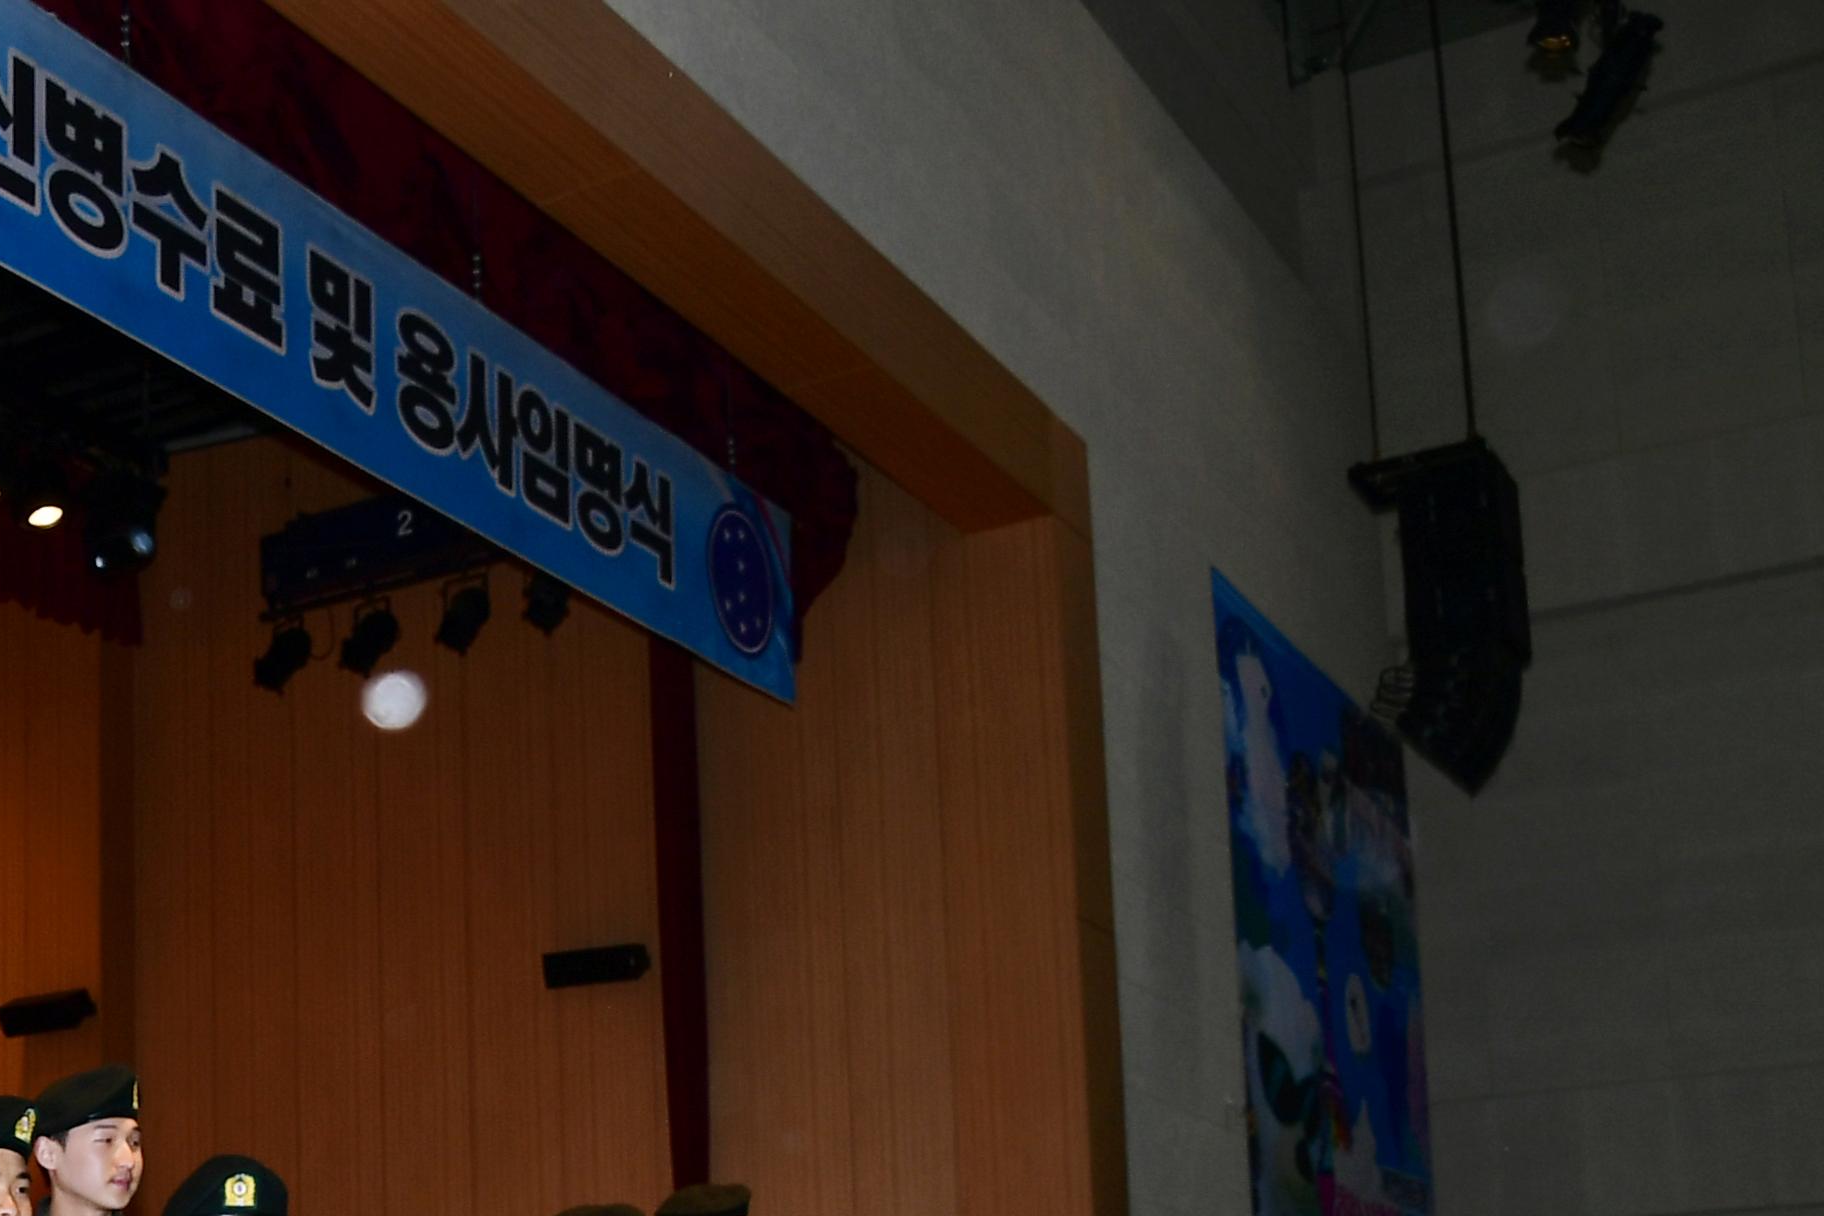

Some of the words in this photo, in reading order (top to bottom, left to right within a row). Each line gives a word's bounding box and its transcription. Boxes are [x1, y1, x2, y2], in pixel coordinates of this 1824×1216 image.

[308, 246, 375, 414] 및
[395, 309, 675, 590] 용사임명식
[397, 510, 413, 536] 2
